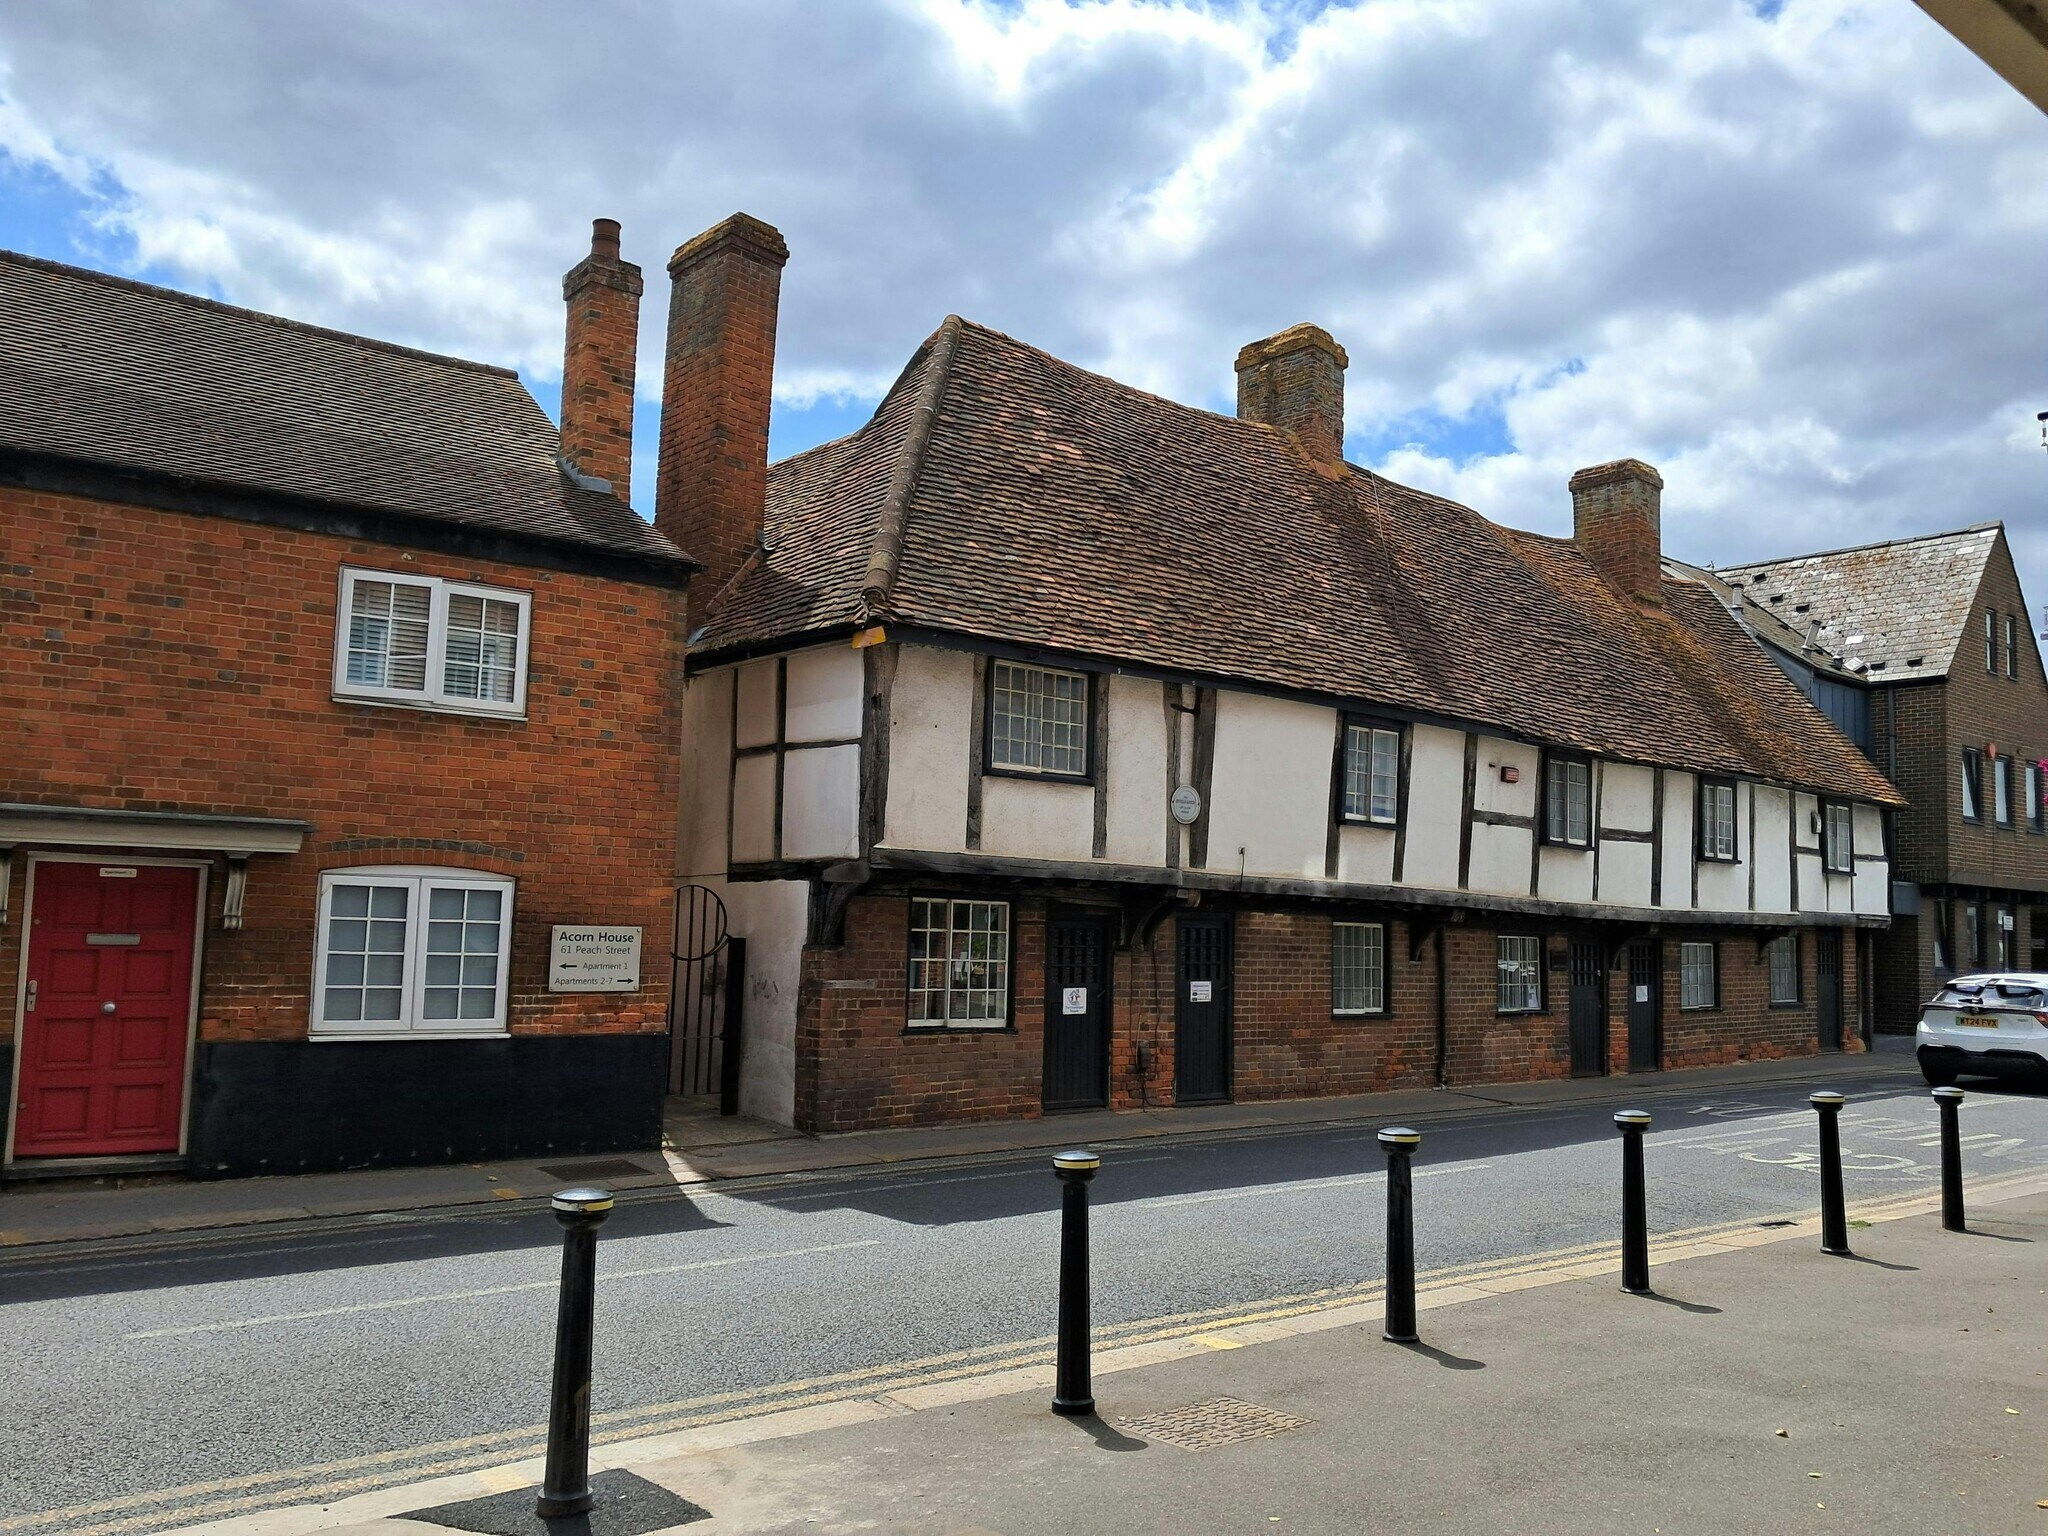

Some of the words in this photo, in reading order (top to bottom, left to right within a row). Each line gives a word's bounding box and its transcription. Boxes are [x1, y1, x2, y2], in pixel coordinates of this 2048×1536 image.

[559, 931, 594, 942] Acorn
[598, 932, 634, 943] House
[560, 945, 572, 954] 61
[575, 945, 602, 954] Peach
[605, 946, 631, 954] Street
[582, 962, 622, 971] Apartment
[554, 977, 598, 986] Apartments
